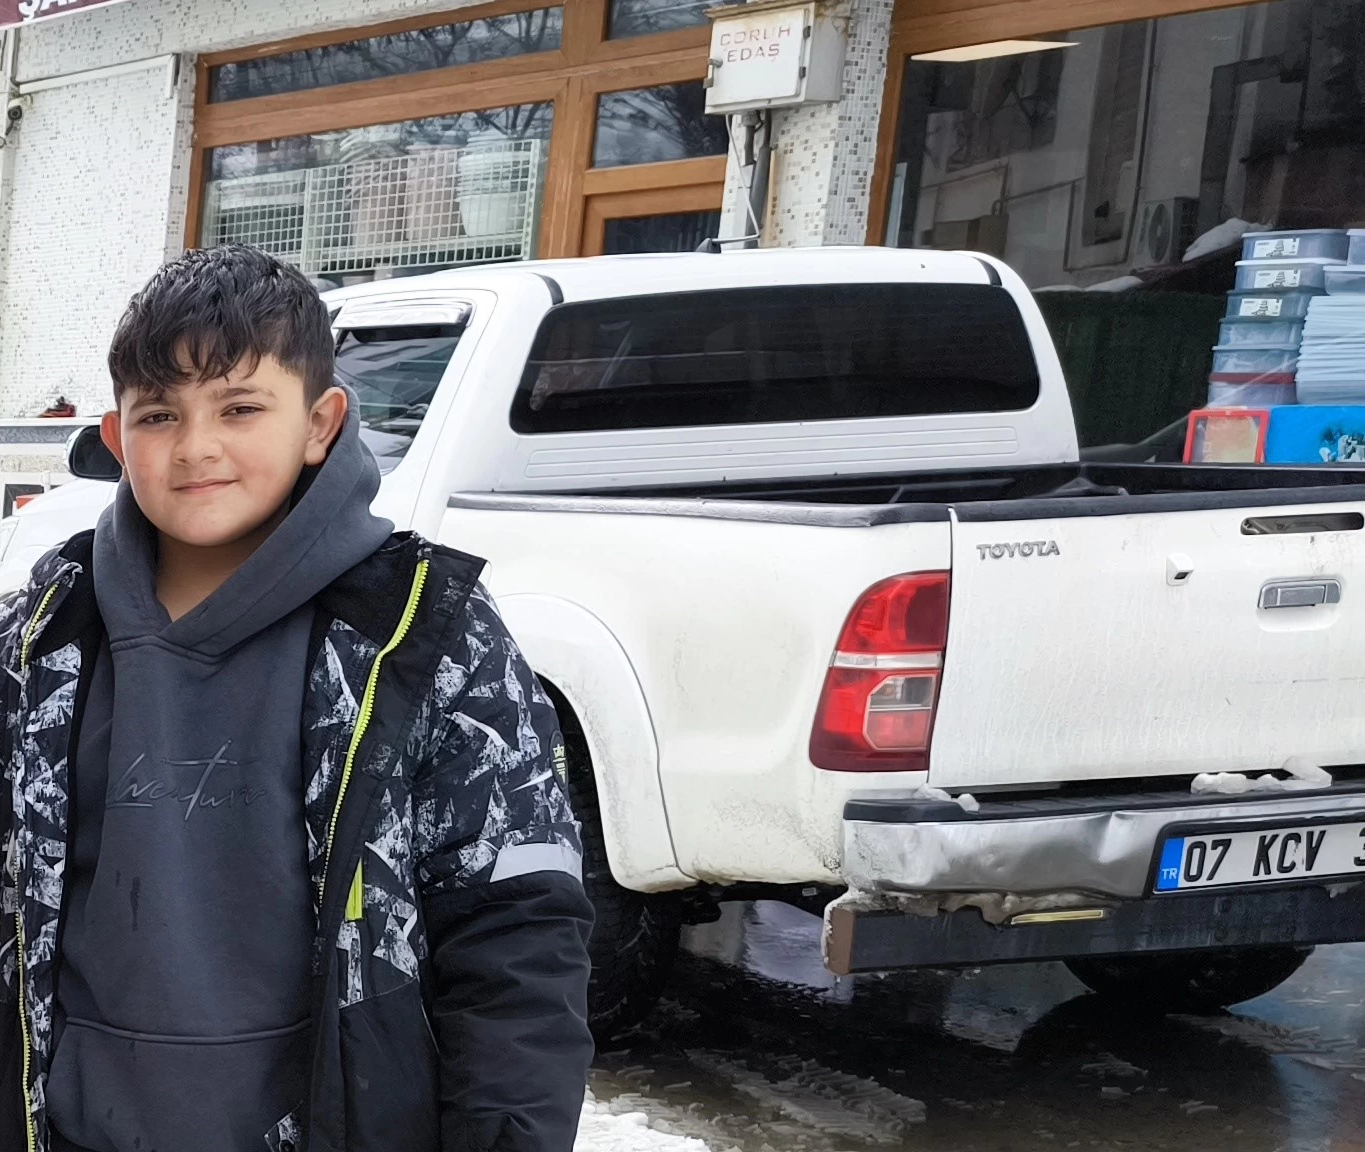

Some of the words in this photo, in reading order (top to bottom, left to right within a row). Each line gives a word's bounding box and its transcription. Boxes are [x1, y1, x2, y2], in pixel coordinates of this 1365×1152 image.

[975, 540, 1060, 560] TOYOTA
[1183, 838, 1233, 883] 07
[1252, 830, 1327, 877] KCV
[1162, 868, 1178, 880] TR
